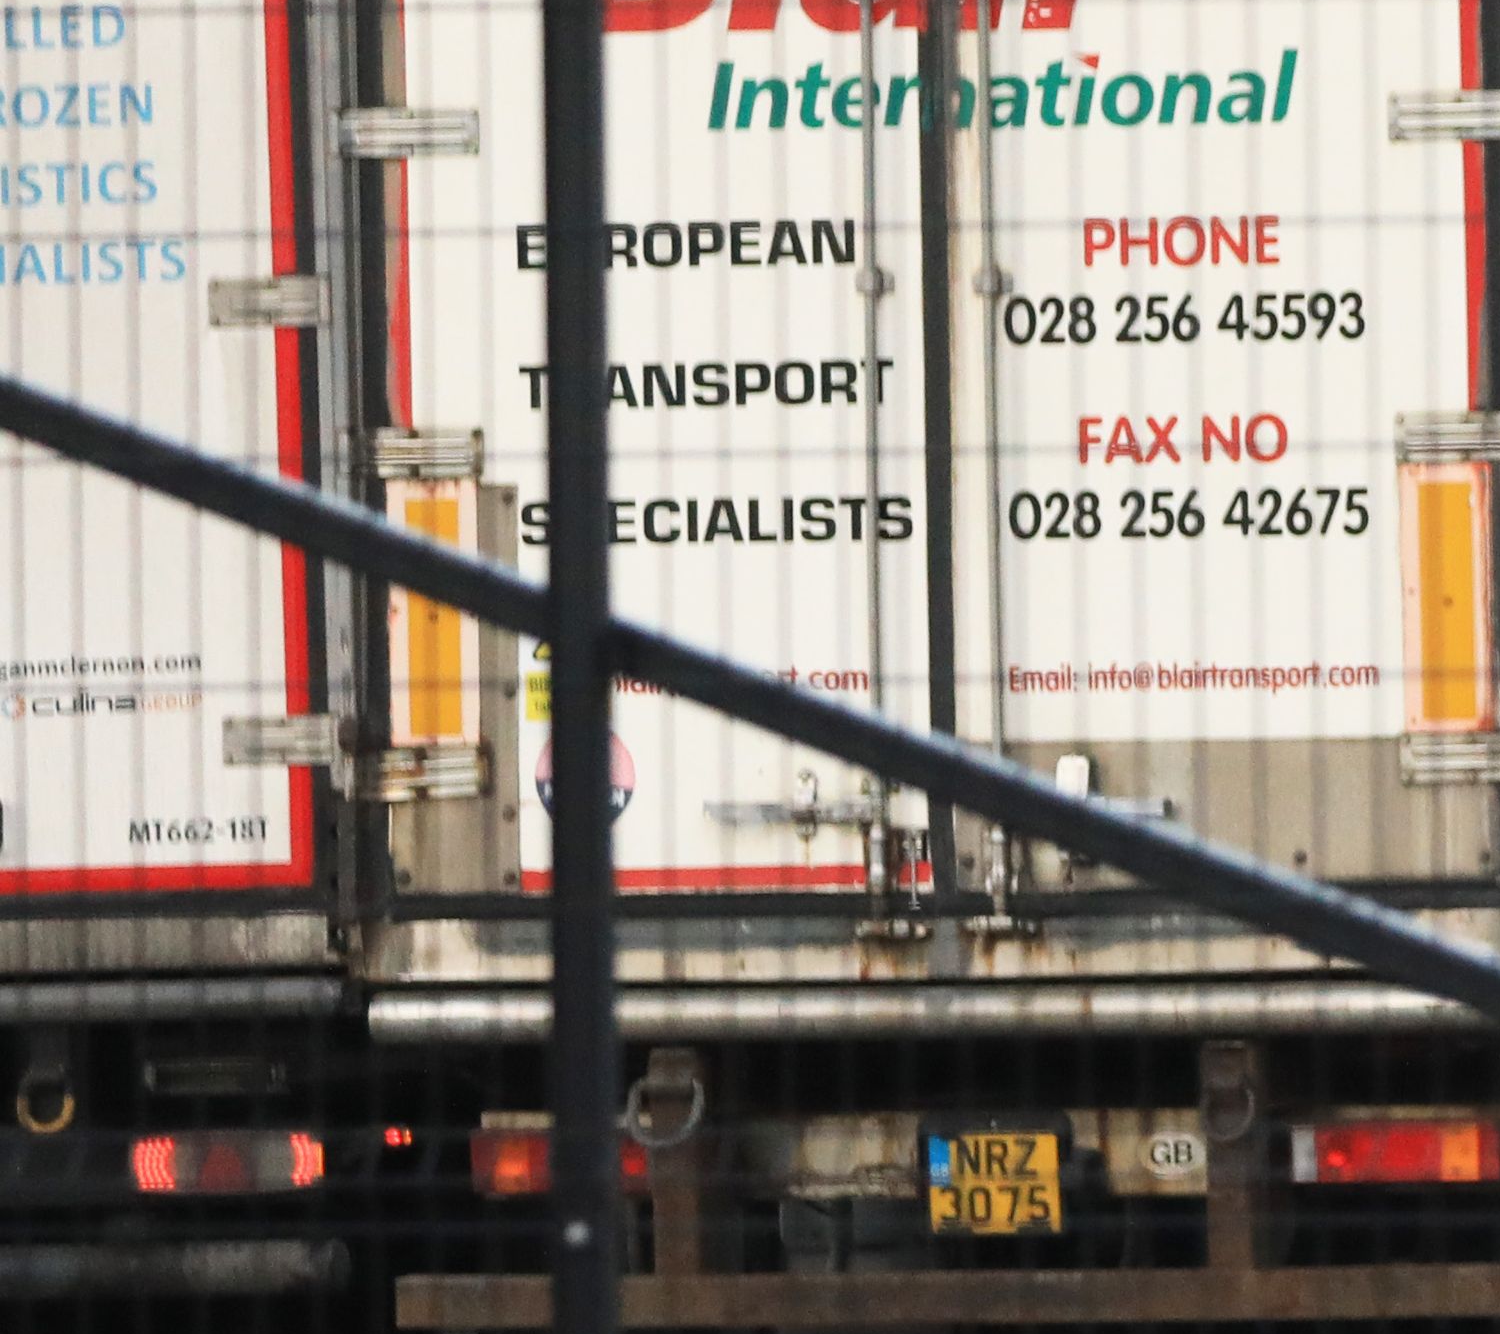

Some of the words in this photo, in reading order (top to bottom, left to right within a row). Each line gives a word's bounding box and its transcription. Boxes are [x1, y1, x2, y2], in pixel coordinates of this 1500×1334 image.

[0, 83, 153, 129] OZEN
[708, 47, 1299, 131] International
[517, 218, 856, 270] EROPEAN
[1083, 215, 1280, 267] PHONE
[1003, 296, 1097, 347] 028
[1114, 294, 1202, 345] 256
[1218, 290, 1367, 342] 45593
[518, 359, 895, 410] TANSPORT
[1077, 414, 1183, 466] FAX
[1201, 412, 1289, 465] NO
[519, 495, 913, 547] SECIALISTS
[1009, 489, 1102, 543] 028
[1120, 488, 1206, 540] 256
[1223, 486, 1370, 538] 42675
[1009, 664, 1078, 693] Email:
[1088, 661, 1380, 696] info@blairtransport.com
[956, 1136, 1038, 1177] NRZ
[1151, 1139, 1193, 1166] GB
[940, 1186, 1051, 1223] 3075
